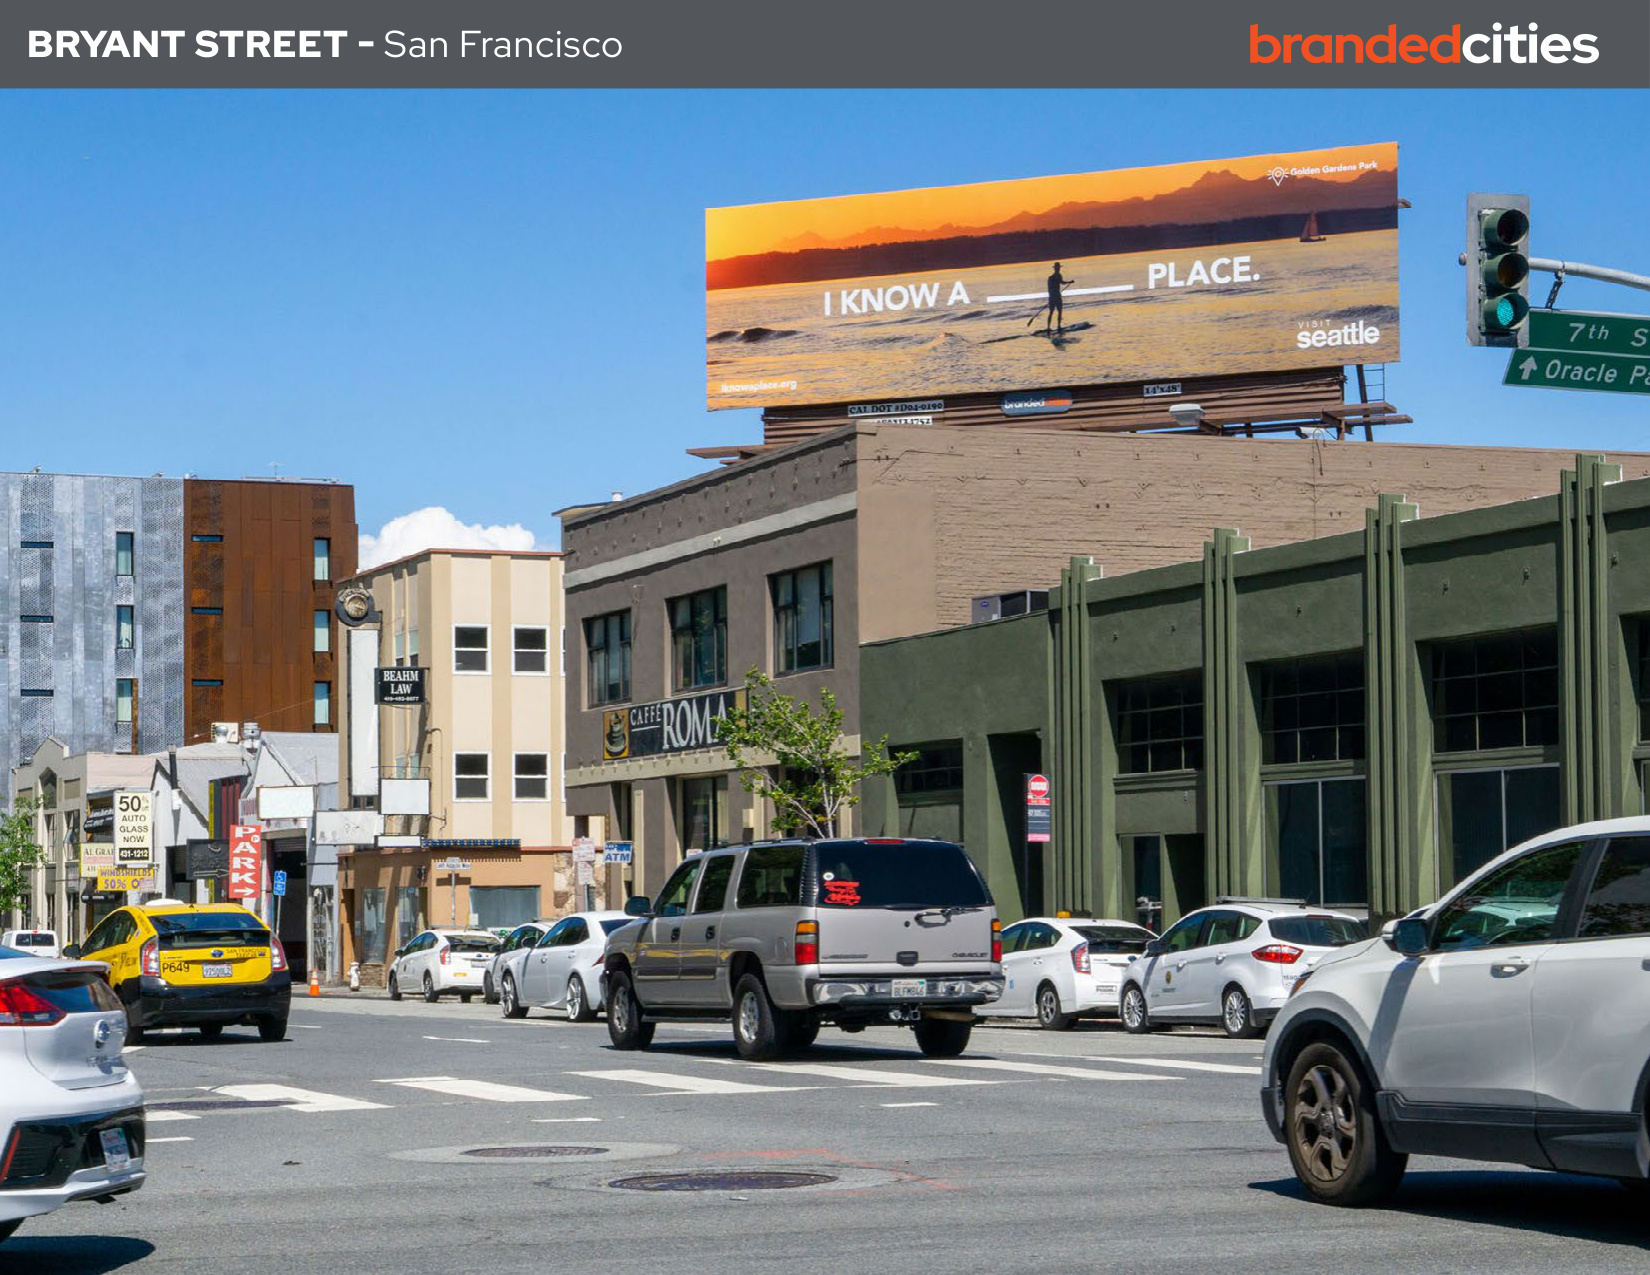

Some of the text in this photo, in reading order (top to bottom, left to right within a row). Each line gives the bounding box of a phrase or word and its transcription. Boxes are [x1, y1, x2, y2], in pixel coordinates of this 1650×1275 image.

[1290, 161, 1378, 176] Golden Gardens Park
[824, 255, 1261, 316] I KNOW A PLACE.
[1297, 319, 1332, 329] VISIT
[1296, 320, 1380, 349] seattle
[1568, 322, 1610, 343] 7th
[1545, 359, 1618, 384] Oracle
[849, 406, 870, 415] CAL
[871, 404, 893, 413] DOT
[383, 670, 419, 682] BEAHM
[390, 683, 413, 694] LAW
[662, 694, 732, 750] ROMA
[119, 795, 141, 812] 50
[121, 814, 147, 822] AUTO
[119, 825, 149, 833] GLASS
[119, 849, 149, 858] 431-1212
[231, 826, 258, 885] PARK
[604, 853, 630, 861] ATM
[100, 868, 152, 877] WINDSHIELDS
[103, 878, 127, 890] 50%
[162, 962, 190, 973] P649
